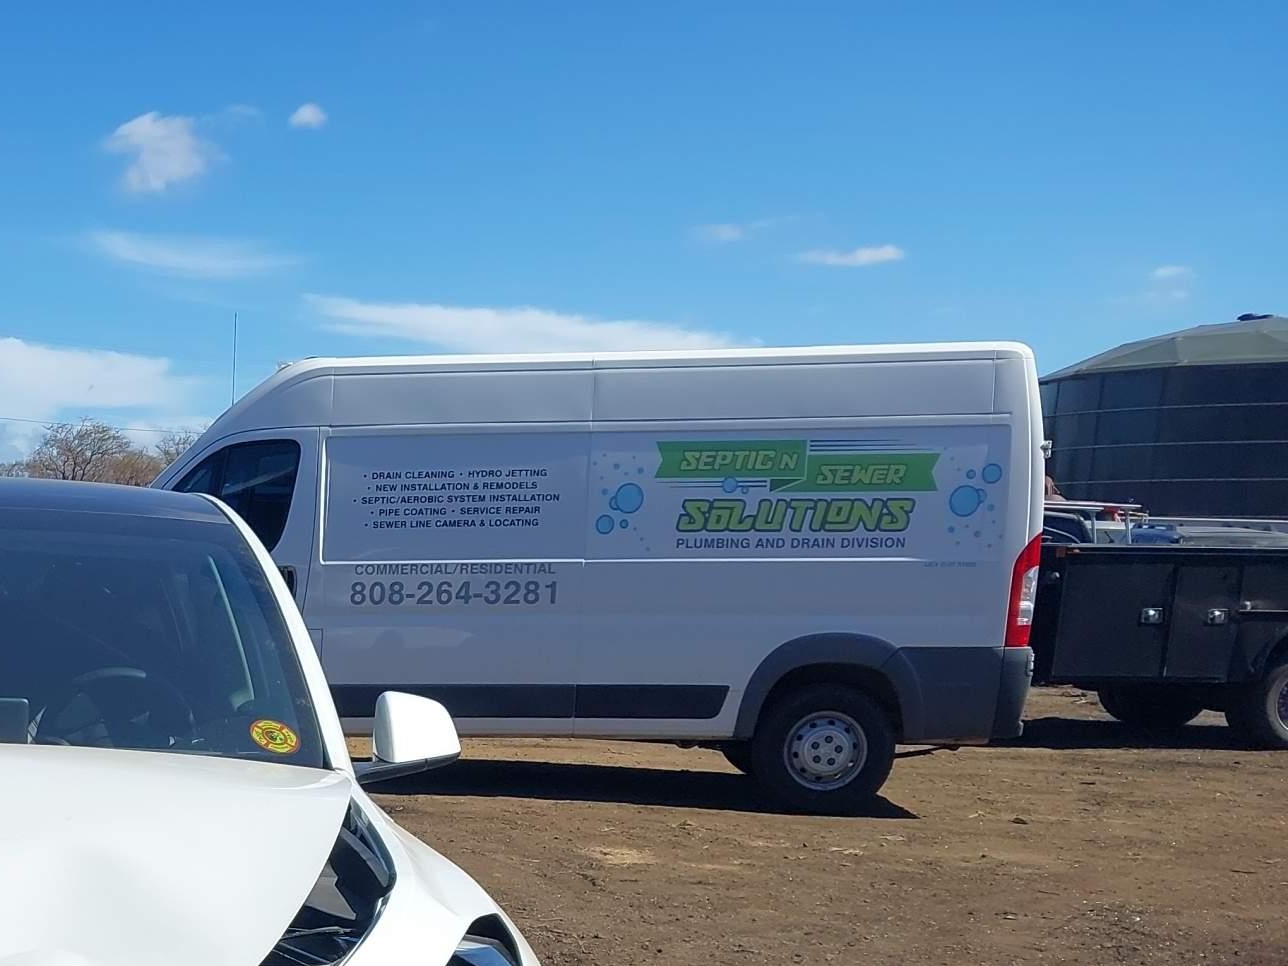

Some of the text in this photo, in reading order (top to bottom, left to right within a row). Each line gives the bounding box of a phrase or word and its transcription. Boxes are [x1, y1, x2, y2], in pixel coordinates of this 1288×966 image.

[680, 450, 799, 471] SEPTIC N
[372, 469, 548, 480] DRAIN CLEANING HYDRO JETTING
[815, 464, 907, 485] SEWER
[375, 481, 538, 492] NEW INSTALLATION & REMODELS
[361, 493, 560, 505] SEPTIC/AEROBIC SYSTEM INSTALLATION
[378, 506, 541, 517] PIPE COATING SERVICE REPAIR
[675, 498, 916, 532] SOLUTIONS
[372, 518, 539, 529] SEWER LINE CAMERA & LOCATING
[675, 537, 906, 549] PLUMBING AND DRAIN DIVISION
[354, 563, 557, 576] COMMERCIAL/RESIDENTIAL
[350, 580, 559, 606] 808-264-3281
